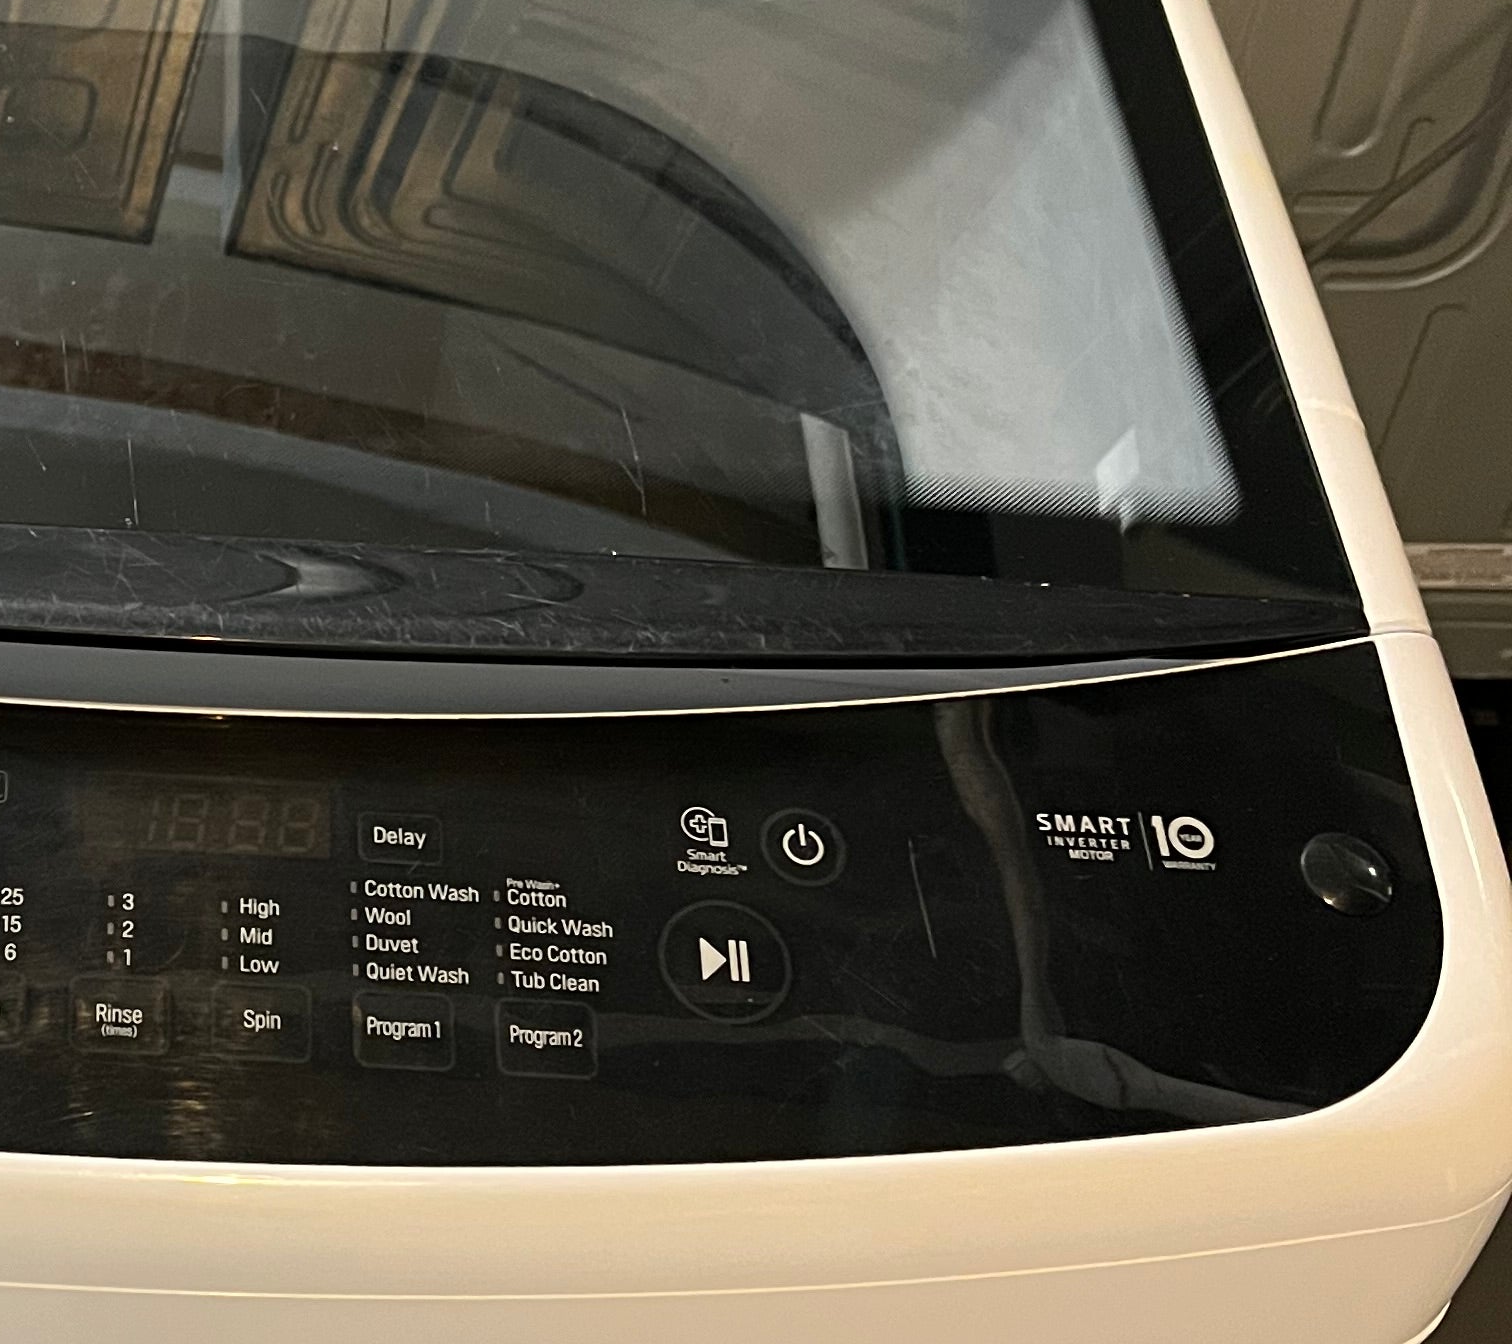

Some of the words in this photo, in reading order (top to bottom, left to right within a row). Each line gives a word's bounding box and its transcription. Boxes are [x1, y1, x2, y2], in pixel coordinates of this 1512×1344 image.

[1036, 813, 1131, 836] SMART
[373, 826, 427, 850] Delay
[1046, 835, 1131, 850] INVERTER
[1151, 815, 1215, 859] 10
[686, 848, 728, 863] Smart
[1068, 849, 1115, 861] MOTOR
[0, 888, 24, 905] 25
[364, 879, 425, 900] Cotton
[428, 883, 480, 903] Wash
[507, 889, 567, 908] Cotton
[121, 893, 134, 911] 3
[240, 898, 280, 919] High
[1, 915, 22, 933] 15
[365, 907, 411, 926] Wool
[121, 921, 134, 939] 2
[508, 915, 558, 935] Quick
[561, 919, 614, 938] Wash
[240, 927, 273, 946] Mid
[365, 934, 419, 954] Duvet
[4, 943, 17, 960] 6
[123, 949, 132, 966] 1
[509, 943, 543, 962] Eco
[547, 945, 608, 965] Cotton
[240, 955, 279, 974] Low
[366, 962, 414, 982] Quiet
[417, 965, 470, 985] Wash
[511, 970, 546, 990] Tub
[549, 973, 600, 992] Clean
[95, 1003, 143, 1025] Rinse
[242, 1009, 282, 1031] Spin
